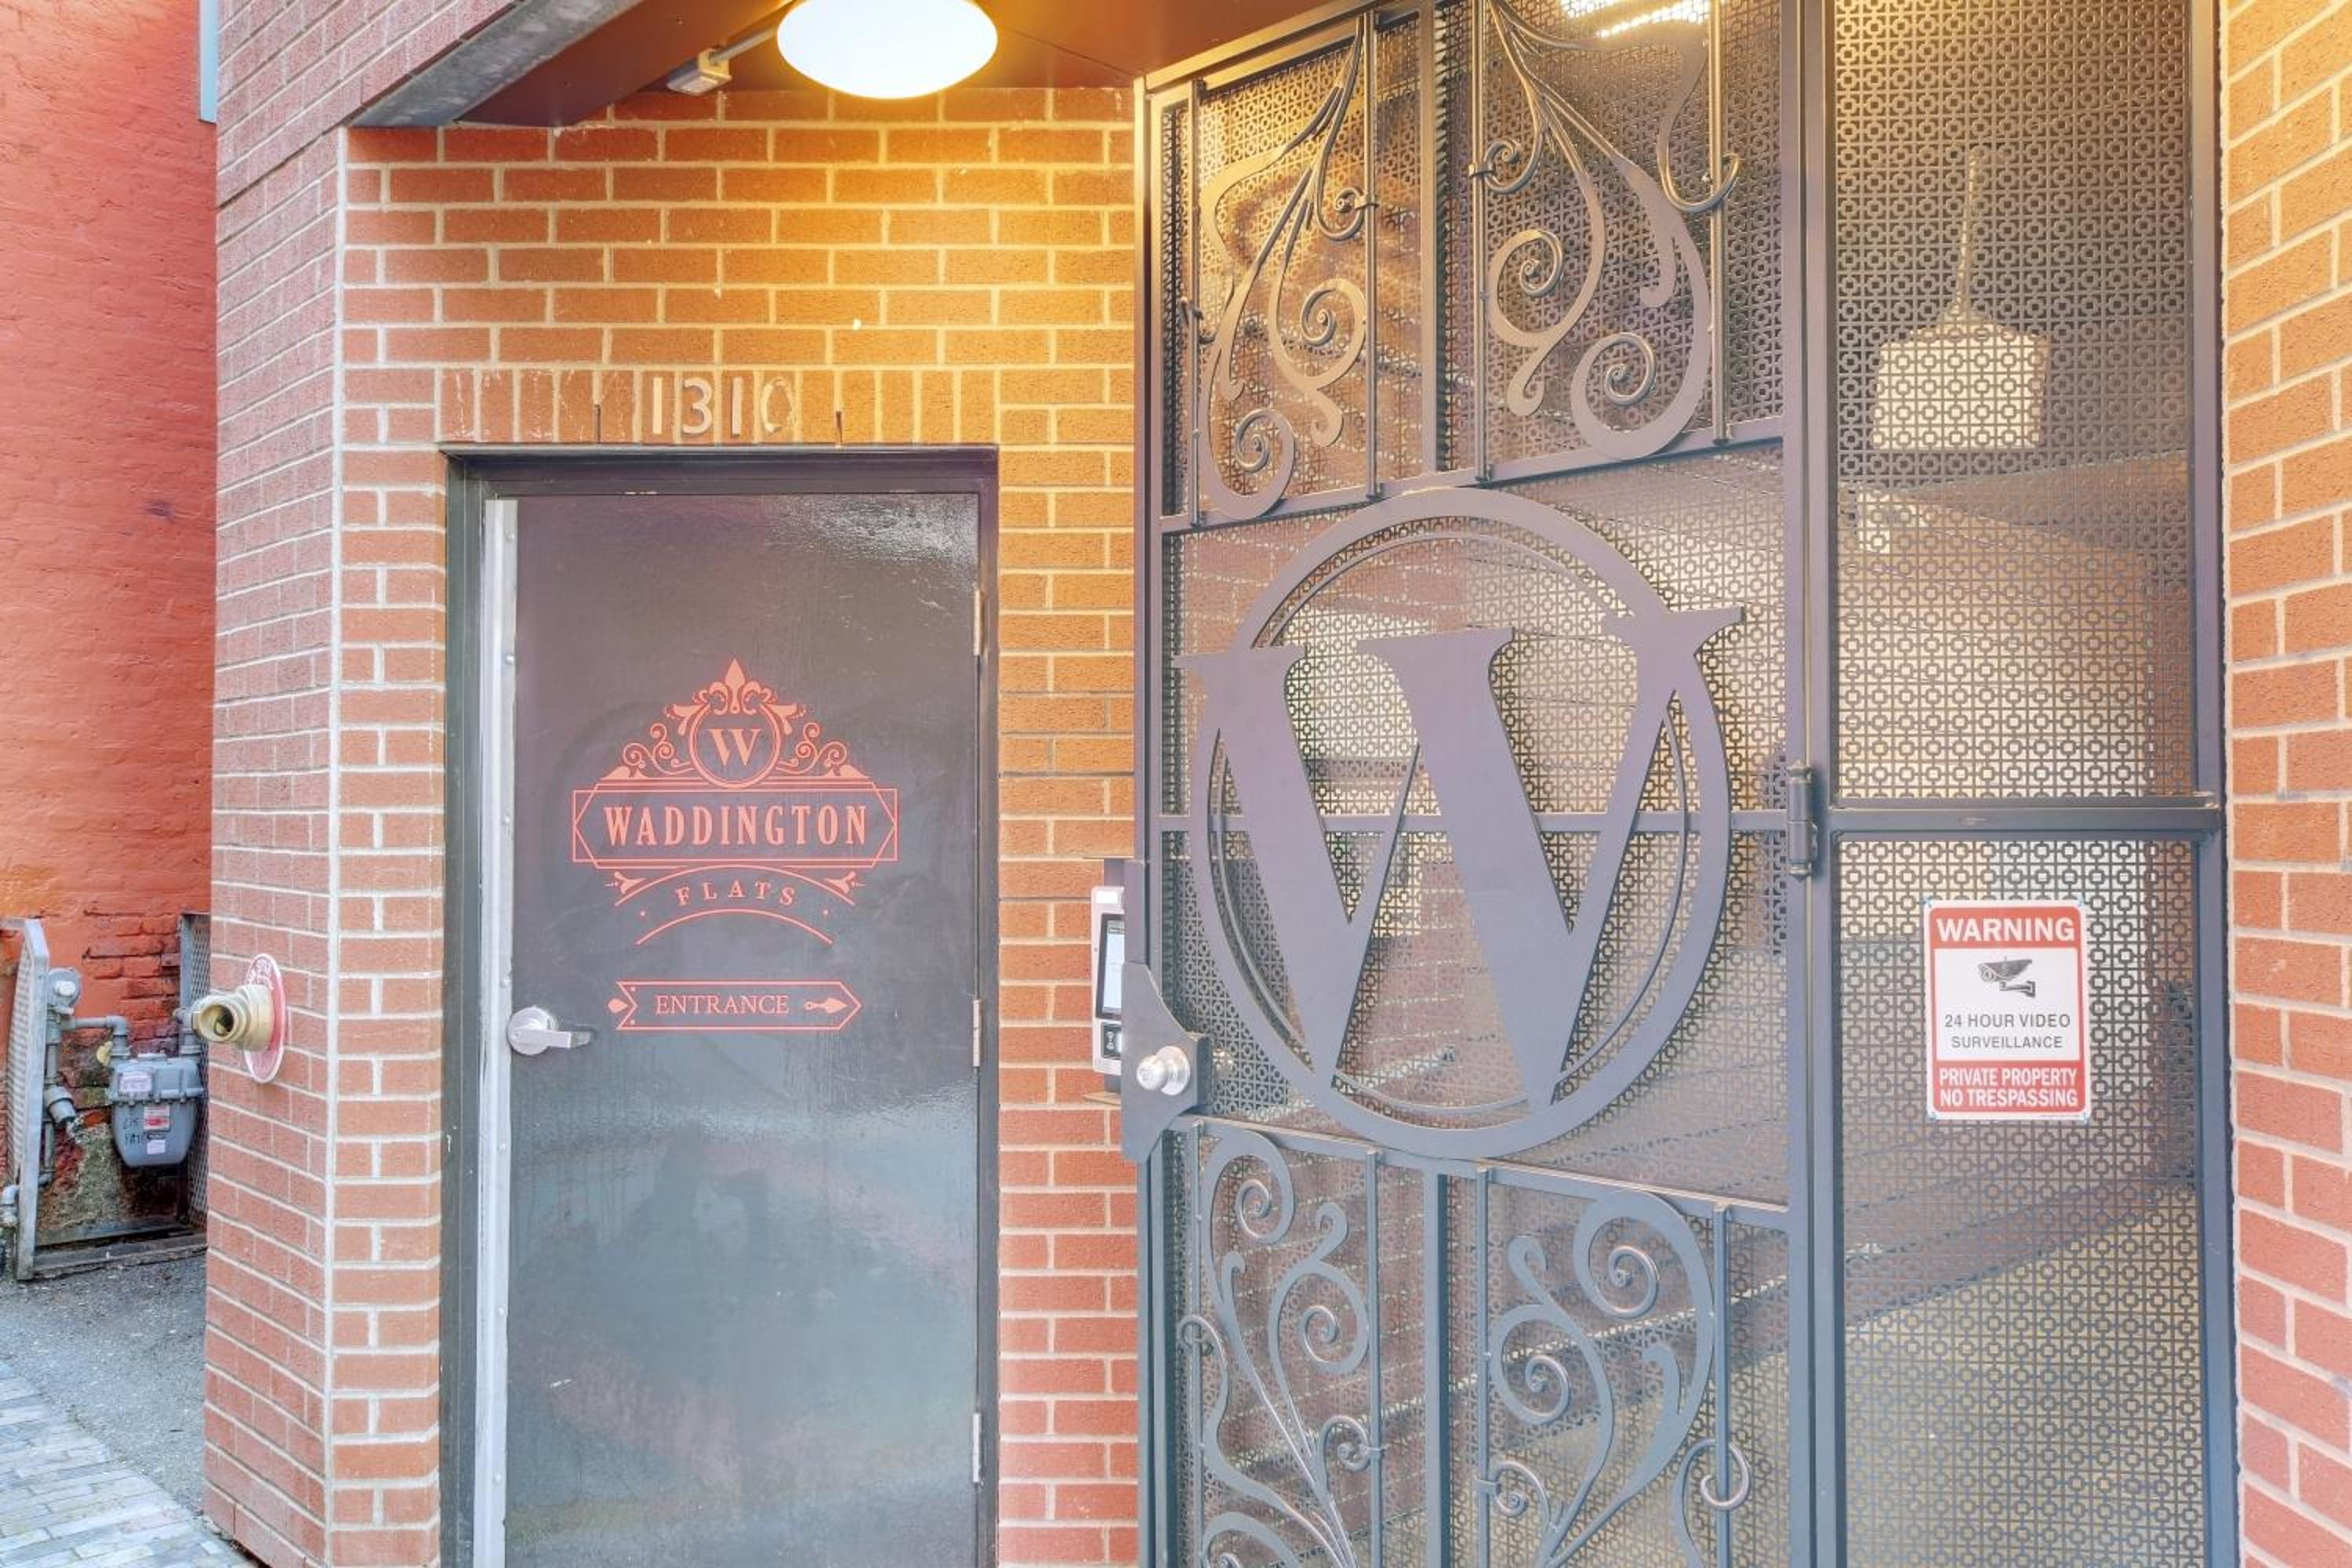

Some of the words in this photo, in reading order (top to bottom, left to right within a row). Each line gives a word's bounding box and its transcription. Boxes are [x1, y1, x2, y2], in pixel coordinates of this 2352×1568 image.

[652, 376, 793, 434] 1310
[707, 728, 761, 766] W
[604, 805, 867, 846] WADDINGTON
[675, 881, 795, 906] FLATS
[1936, 917, 2075, 942] WARNING
[655, 994, 789, 1014] ENTRANCE
[1944, 1014, 1963, 1028] 24
[1967, 1014, 2015, 1028] HOUR
[2019, 1014, 2071, 1028] VIDEO
[1951, 1036, 2063, 1049] SURVEILLANCE
[1939, 1068, 1998, 1087] PRIVATE
[2001, 1067, 2077, 1087] PROPERTY
[1940, 1089, 1965, 1108] NO
[1967, 1088, 2078, 1107] TRESPASSING
